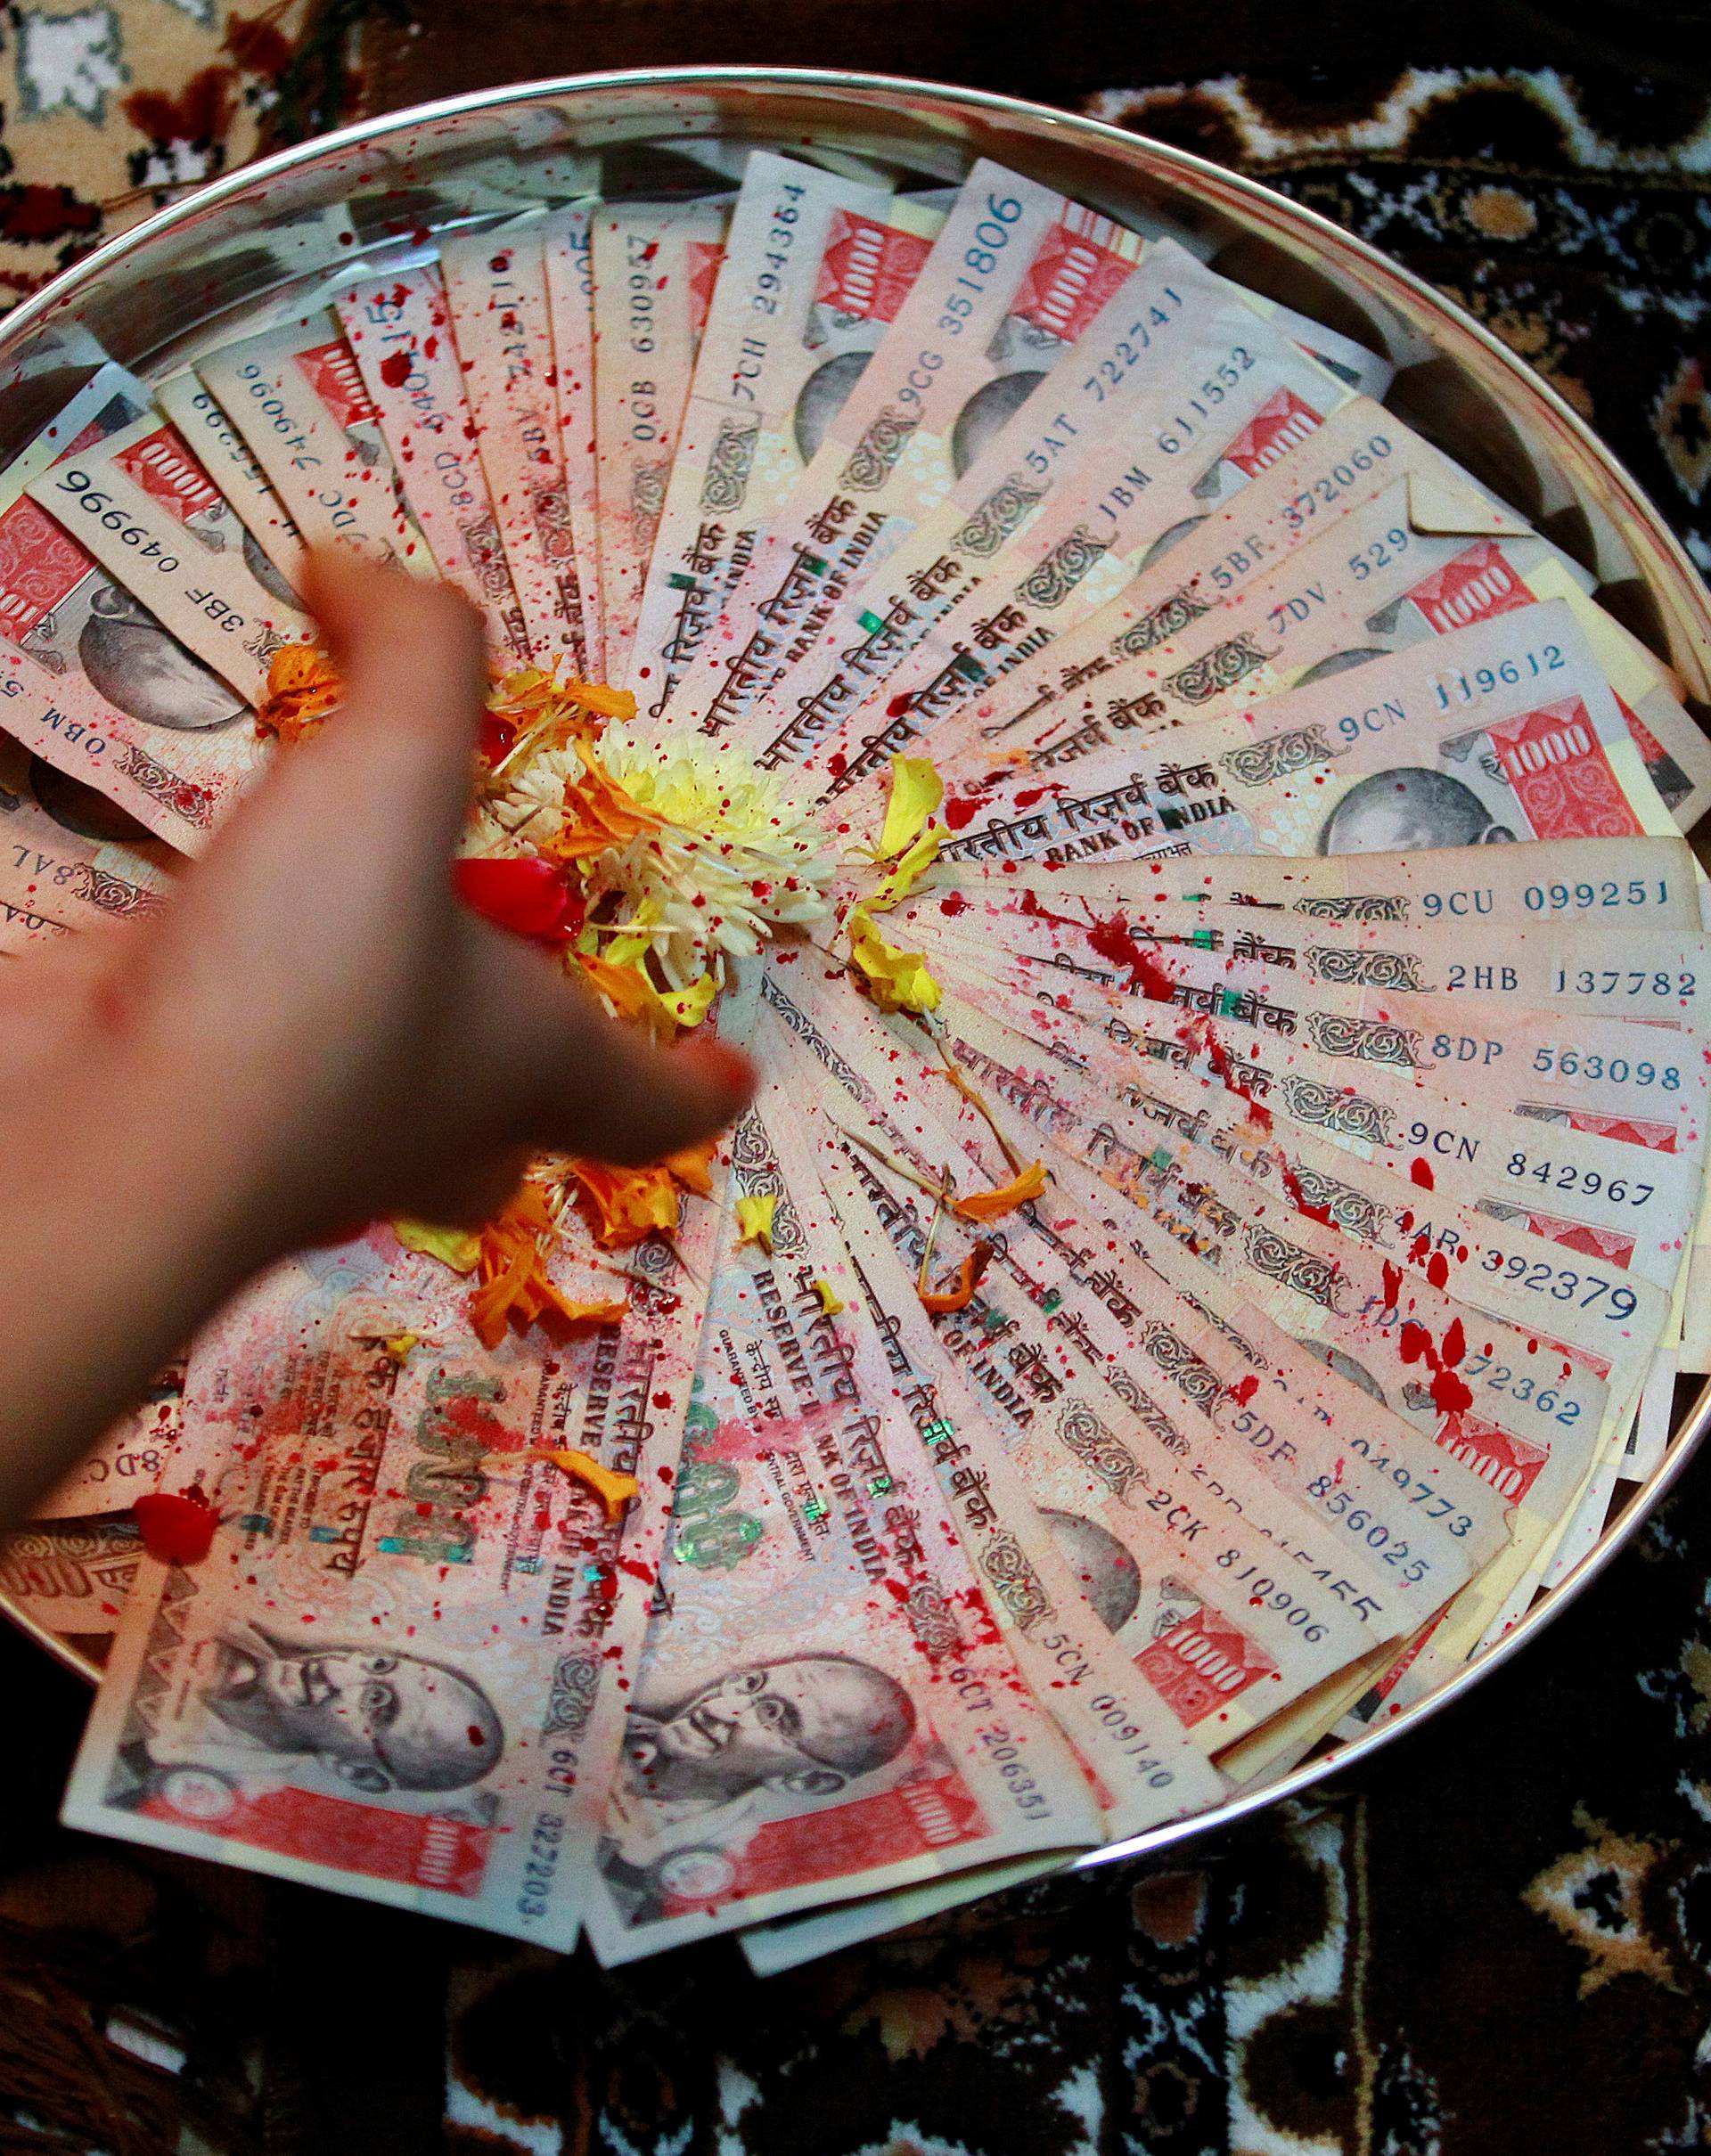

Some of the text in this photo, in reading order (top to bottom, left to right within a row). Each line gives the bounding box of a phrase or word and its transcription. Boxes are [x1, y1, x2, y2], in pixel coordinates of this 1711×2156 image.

[733, 184, 806, 401] 7CH 294364
[897, 192, 1023, 408] 9CG 351806
[364, 299, 444, 429] 64015
[1025, 288, 1182, 474] 5AT 722741
[1158, 346, 1256, 454] 611552
[236, 363, 321, 471] 749096
[54, 470, 244, 633] 3BF 049996
[805, 494, 857, 544] बैंक
[840, 510, 888, 571] INDIA
[1209, 435, 1394, 590] 5BF 372060
[753, 673, 858, 772] भारतीय
[906, 554, 964, 602] बैंक
[970, 604, 1027, 651] बैंक
[1338, 645, 1566, 741] 9CN 119612
[1156, 762, 1221, 800] बैंक
[12, 845, 75, 885] 8AL
[1045, 828, 1117, 864] BANK
[1126, 815, 1156, 843] OF
[1423, 879, 1668, 917] 9CU 099251
[1447, 965, 1696, 997] 2HB 137782
[1431, 1034, 1681, 1090] 8DP 563098
[1407, 1122, 1656, 1206] 9CN 842967
[1481, 1248, 1639, 1321] 392379
[751, 1268, 814, 1394] RESERVE
[830, 1472, 858, 1502] OF
[845, 1507, 888, 1581] INDIA
[971, 1358, 1035, 1430] INDIA
[782, 1492, 816, 1561] GOVERNMENT
[950, 1466, 998, 1531] बैंक
[1230, 1410, 1298, 1463] 5DF
[1306, 1474, 1430, 1582] 856025
[541, 1563, 576, 1637] INDIA
[1145, 1490, 1208, 1542] 2CK
[1216, 1548, 1330, 1644] 810906
[1044, 1633, 1175, 1789] 5CN 009140
